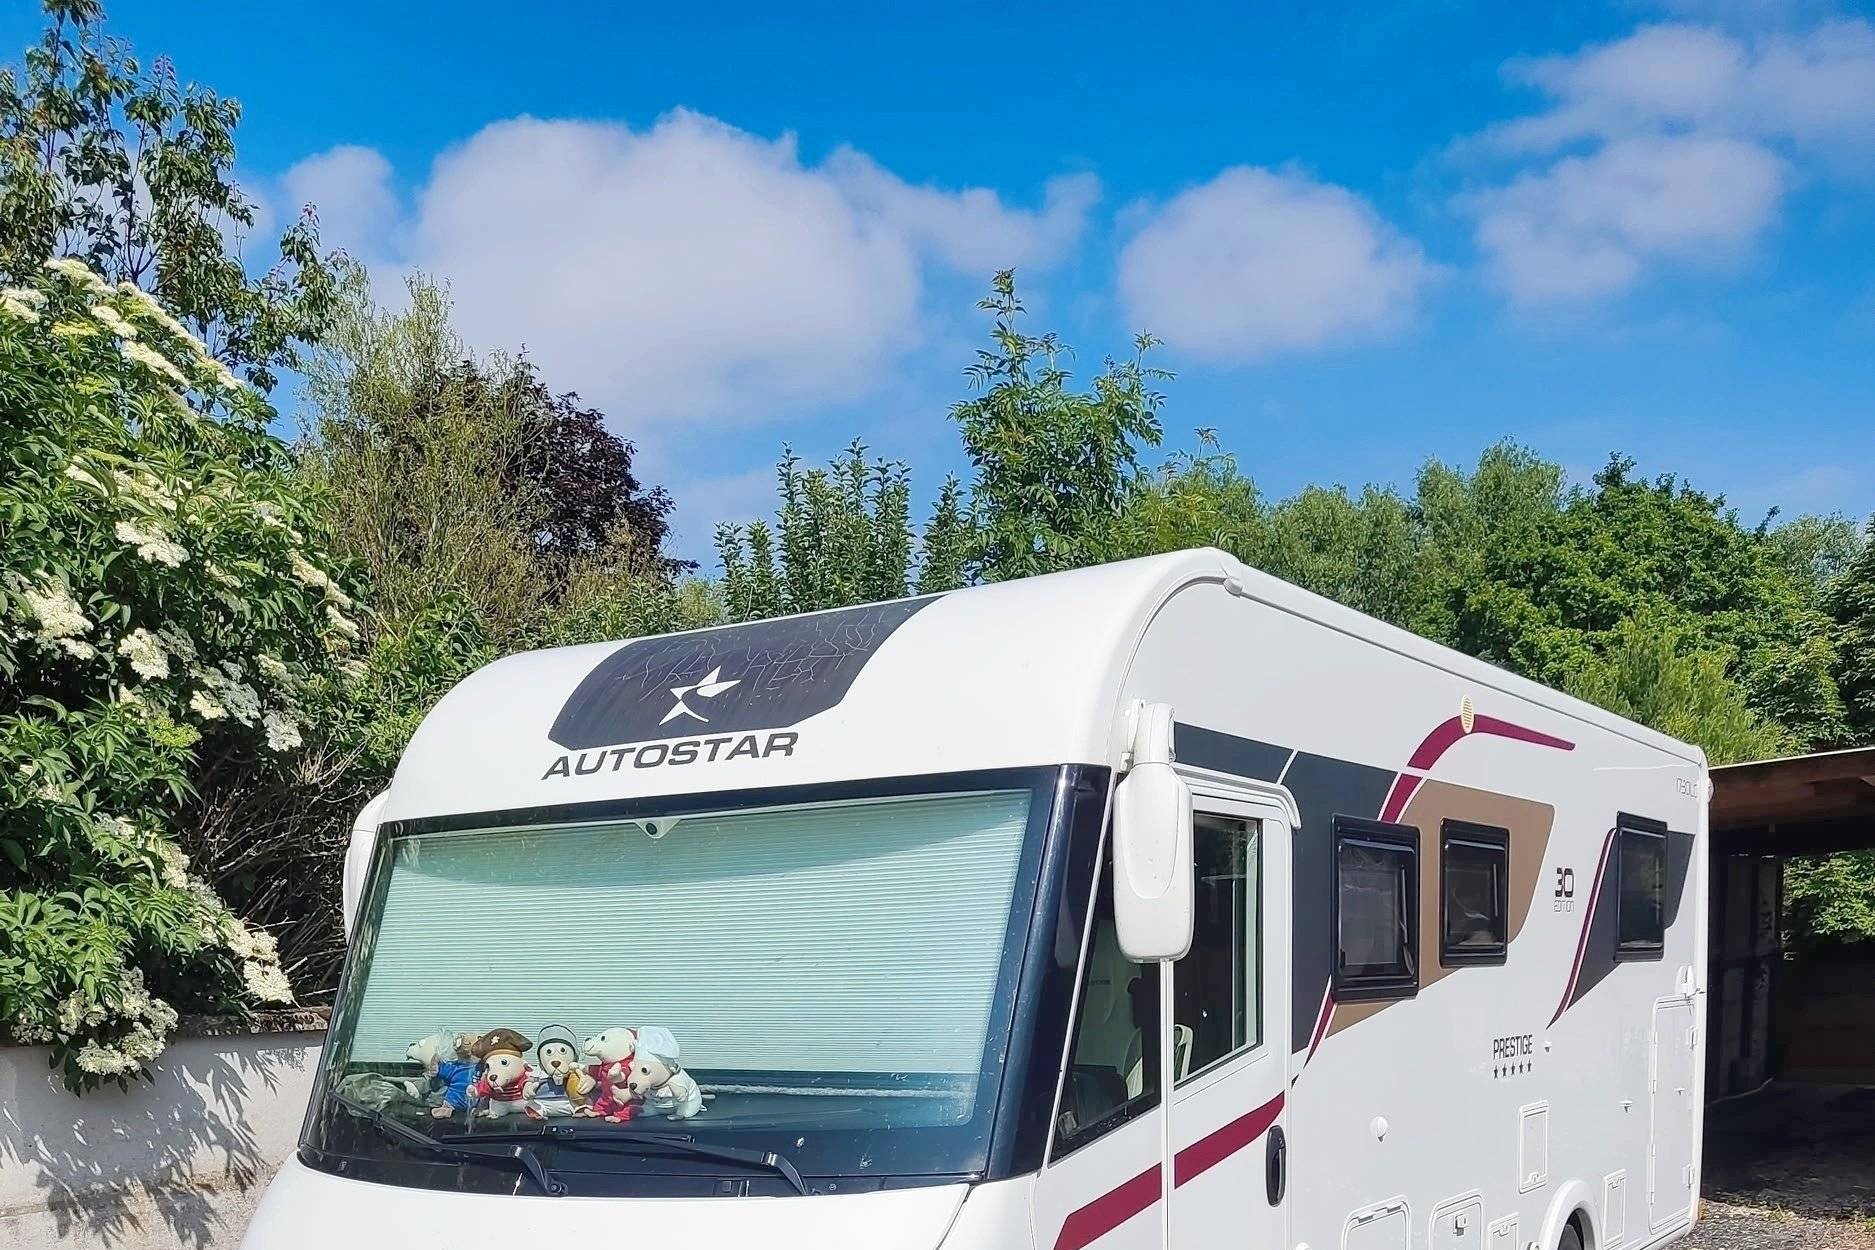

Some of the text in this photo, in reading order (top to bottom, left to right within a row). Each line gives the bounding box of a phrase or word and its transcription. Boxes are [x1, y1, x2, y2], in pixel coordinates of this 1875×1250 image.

[541, 732, 799, 780] AUTOSTAR
[1555, 867, 1575, 897] 30
[1493, 1034, 1533, 1060] PRESTIGE
